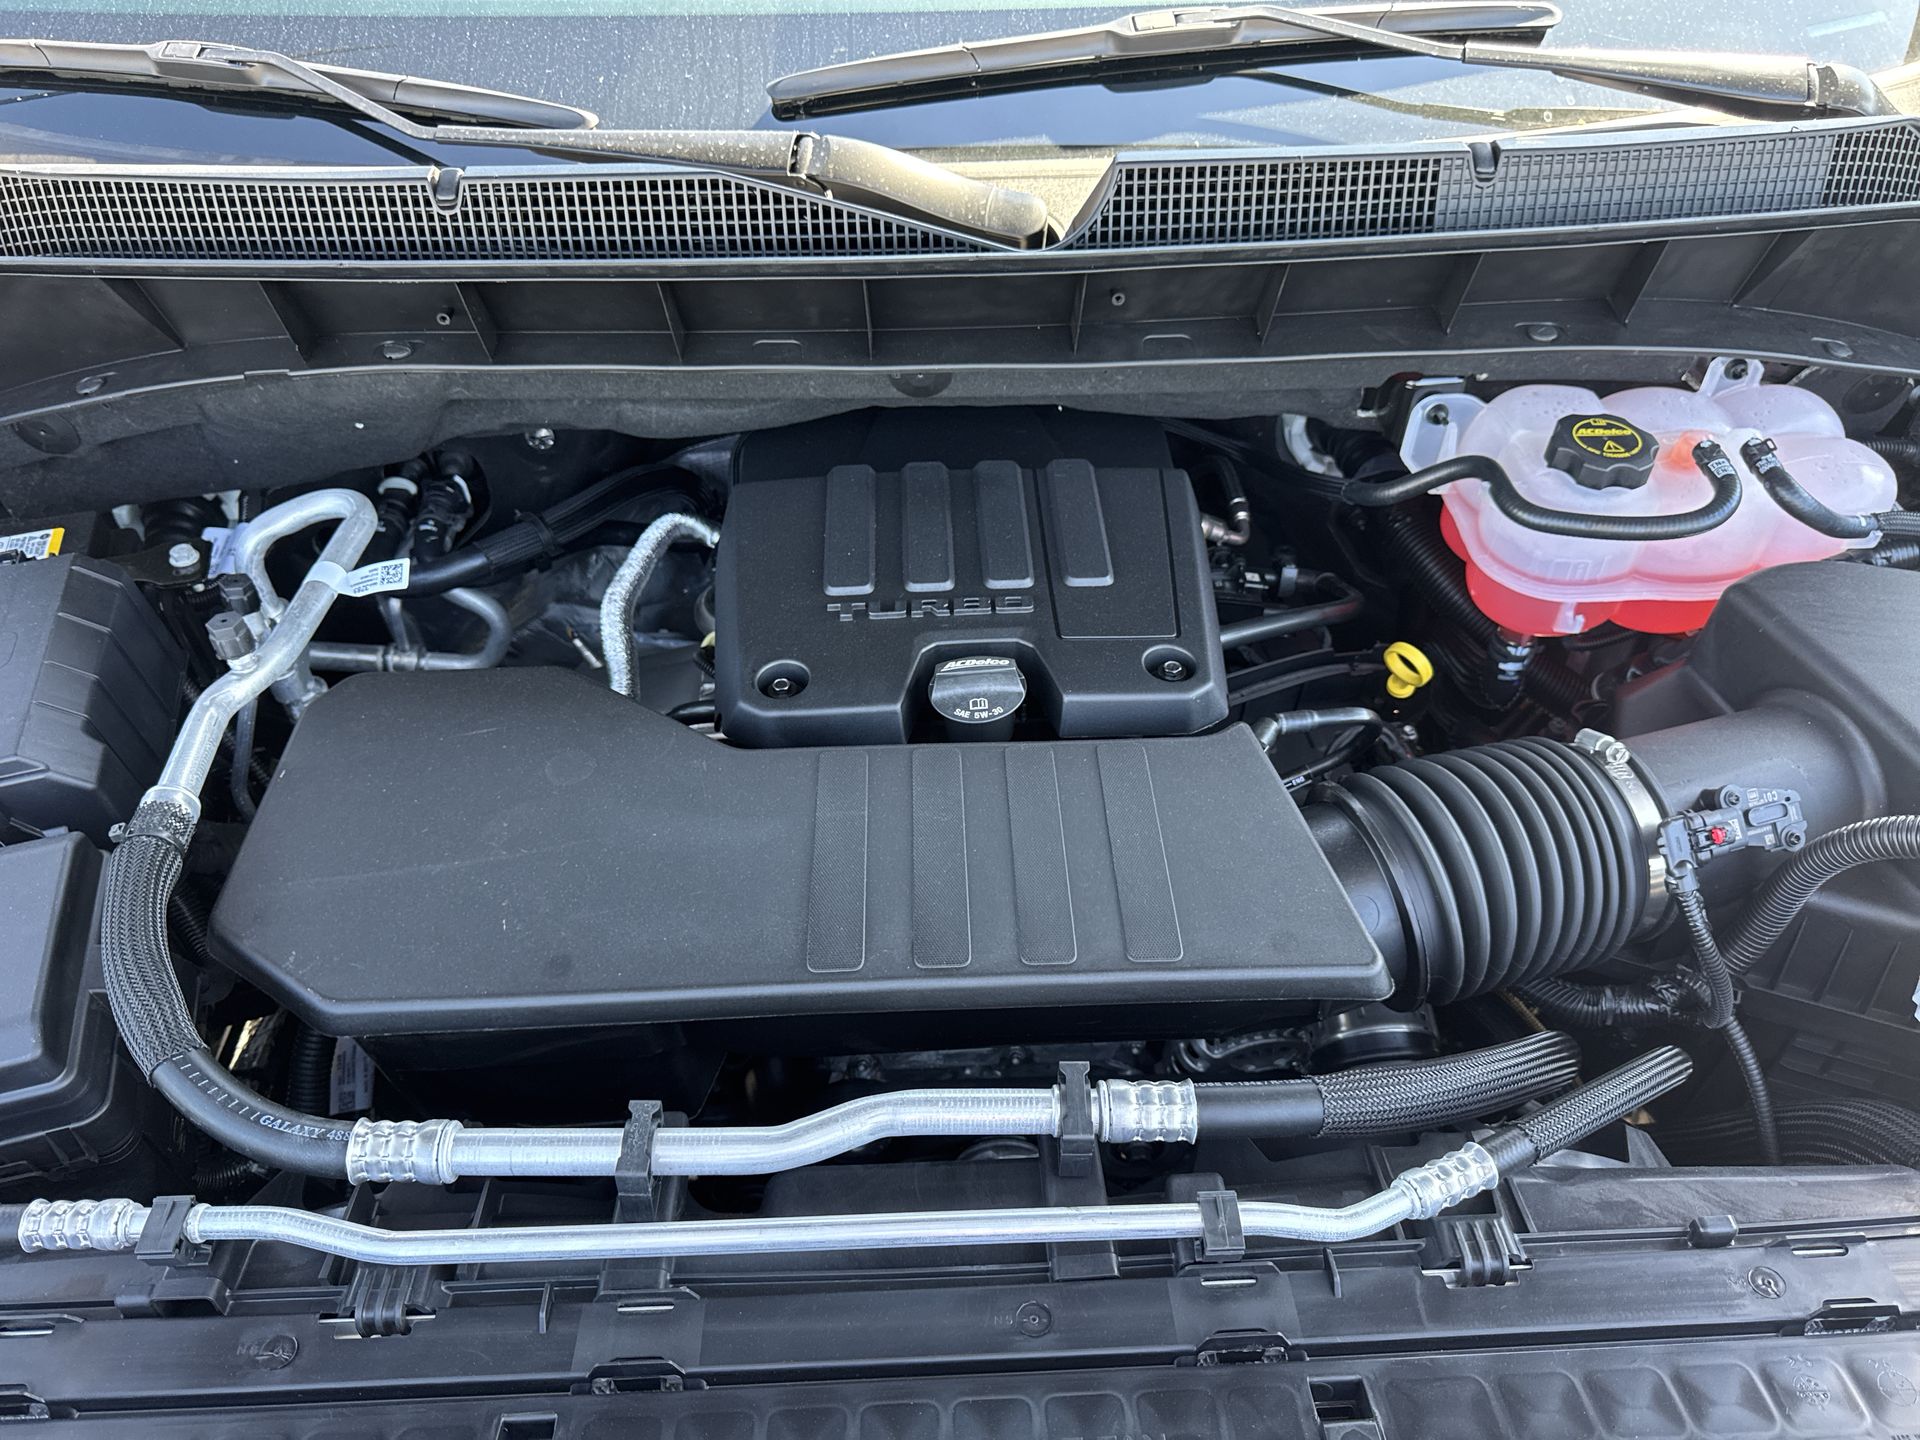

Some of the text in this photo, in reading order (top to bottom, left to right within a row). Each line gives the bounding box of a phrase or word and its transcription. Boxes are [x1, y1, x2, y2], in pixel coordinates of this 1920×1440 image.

[1575, 428, 1632, 436] ACDelco
[827, 596, 1034, 622] TURBO
[941, 658, 1010, 671] ACDelco
[953, 706, 1004, 719] SAE 5W-30
[260, 1115, 326, 1139] GALAXY
